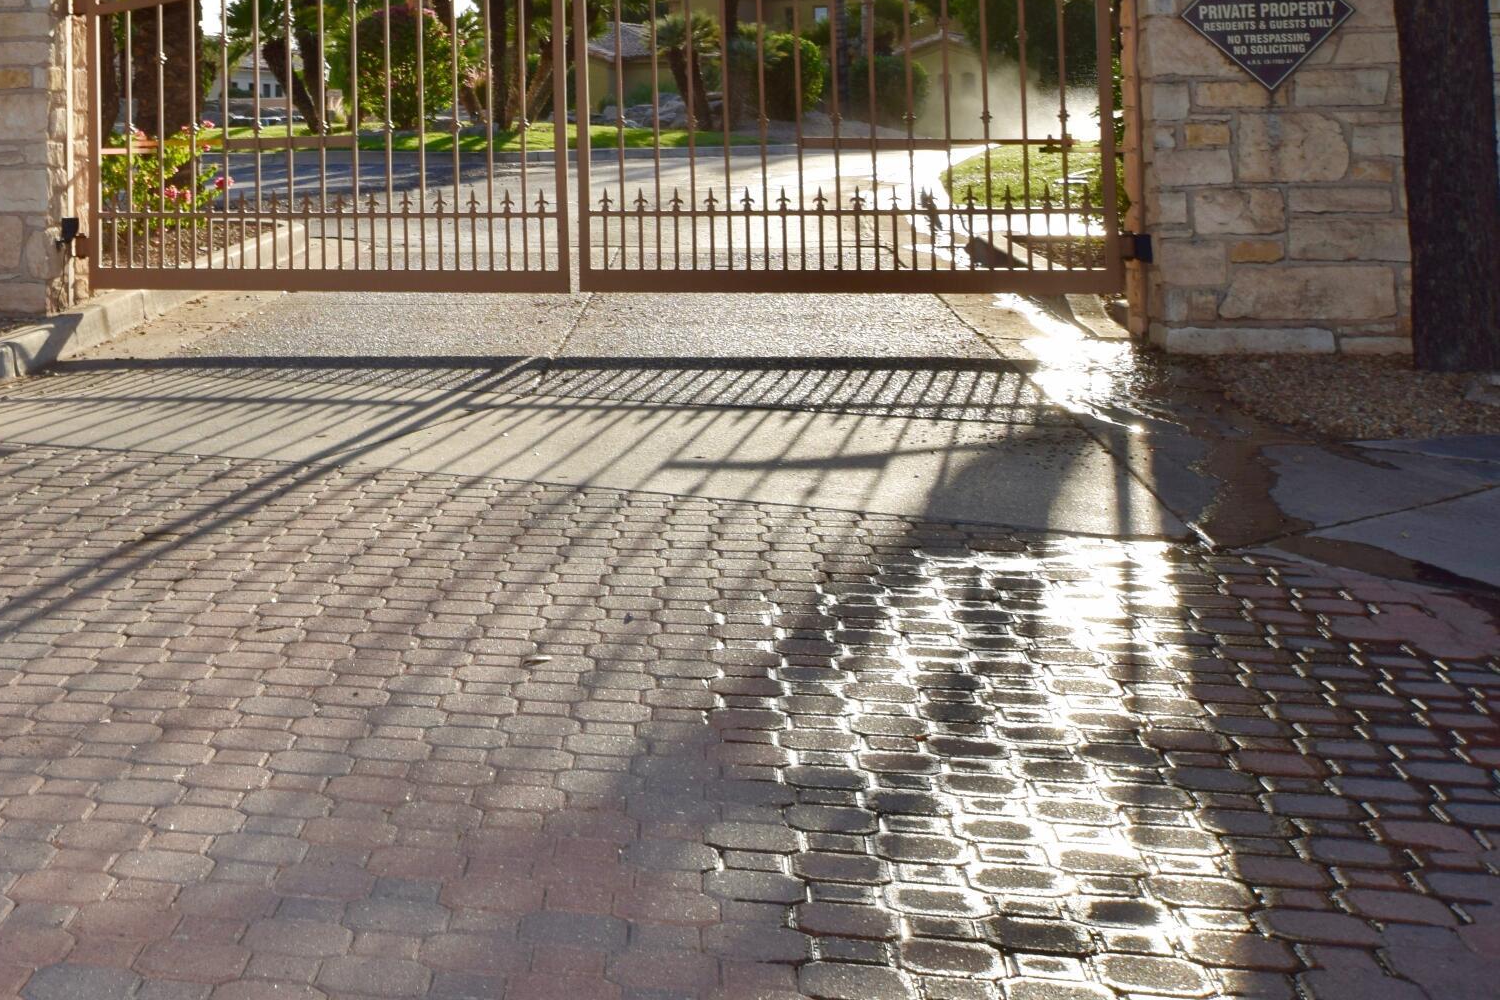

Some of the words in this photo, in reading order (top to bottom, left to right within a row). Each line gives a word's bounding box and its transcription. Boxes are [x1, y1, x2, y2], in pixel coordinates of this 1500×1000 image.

[1199, 4, 1256, 19] PRIVATE
[1260, 1, 1335, 17] PROPERTY
[1203, 20, 1255, 31] RESIDENTS
[1259, 20, 1266, 30] &
[1269, 19, 1306, 30] GUESTS
[1309, 18, 1334, 28] ONLY
[1227, 34, 1241, 45] NO
[1244, 33, 1310, 43] TRESPASSING
[1233, 45, 1247, 55] NO
[1250, 44, 1305, 54] SOLICITING
